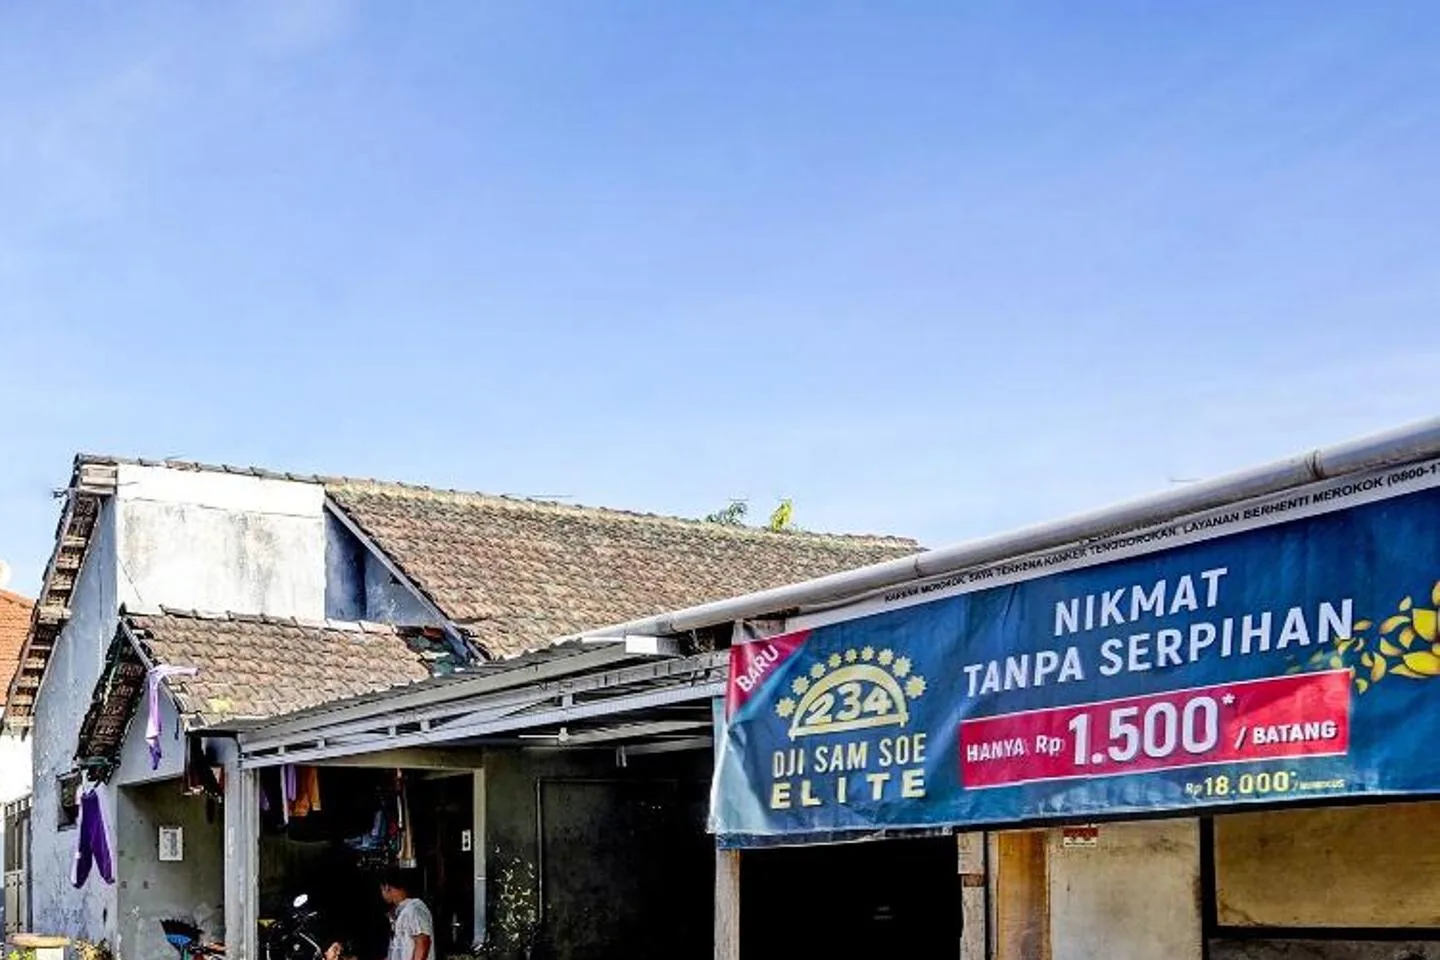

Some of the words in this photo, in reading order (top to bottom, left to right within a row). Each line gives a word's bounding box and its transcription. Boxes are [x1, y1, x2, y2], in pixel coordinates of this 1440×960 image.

[1183, 511, 1239, 534] LAYANAN
[1243, 496, 1310, 519] BERHENTI
[1312, 476, 1384, 504] MEROKOK
[1054, 568, 1227, 636] NIKMAT
[735, 644, 780, 693] BARU
[964, 646, 1084, 697] TANPA
[1099, 599, 1352, 676] SERPIHAN
[805, 682, 892, 724] 234
[773, 748, 804, 778] DJI
[814, 741, 867, 773] SAM
[878, 733, 927, 767] SOE
[966, 737, 1025, 763] HANYA
[1035, 735, 1060, 757] Rp
[1252, 720, 1337, 746] BATANG
[770, 768, 926, 810] ELITE
